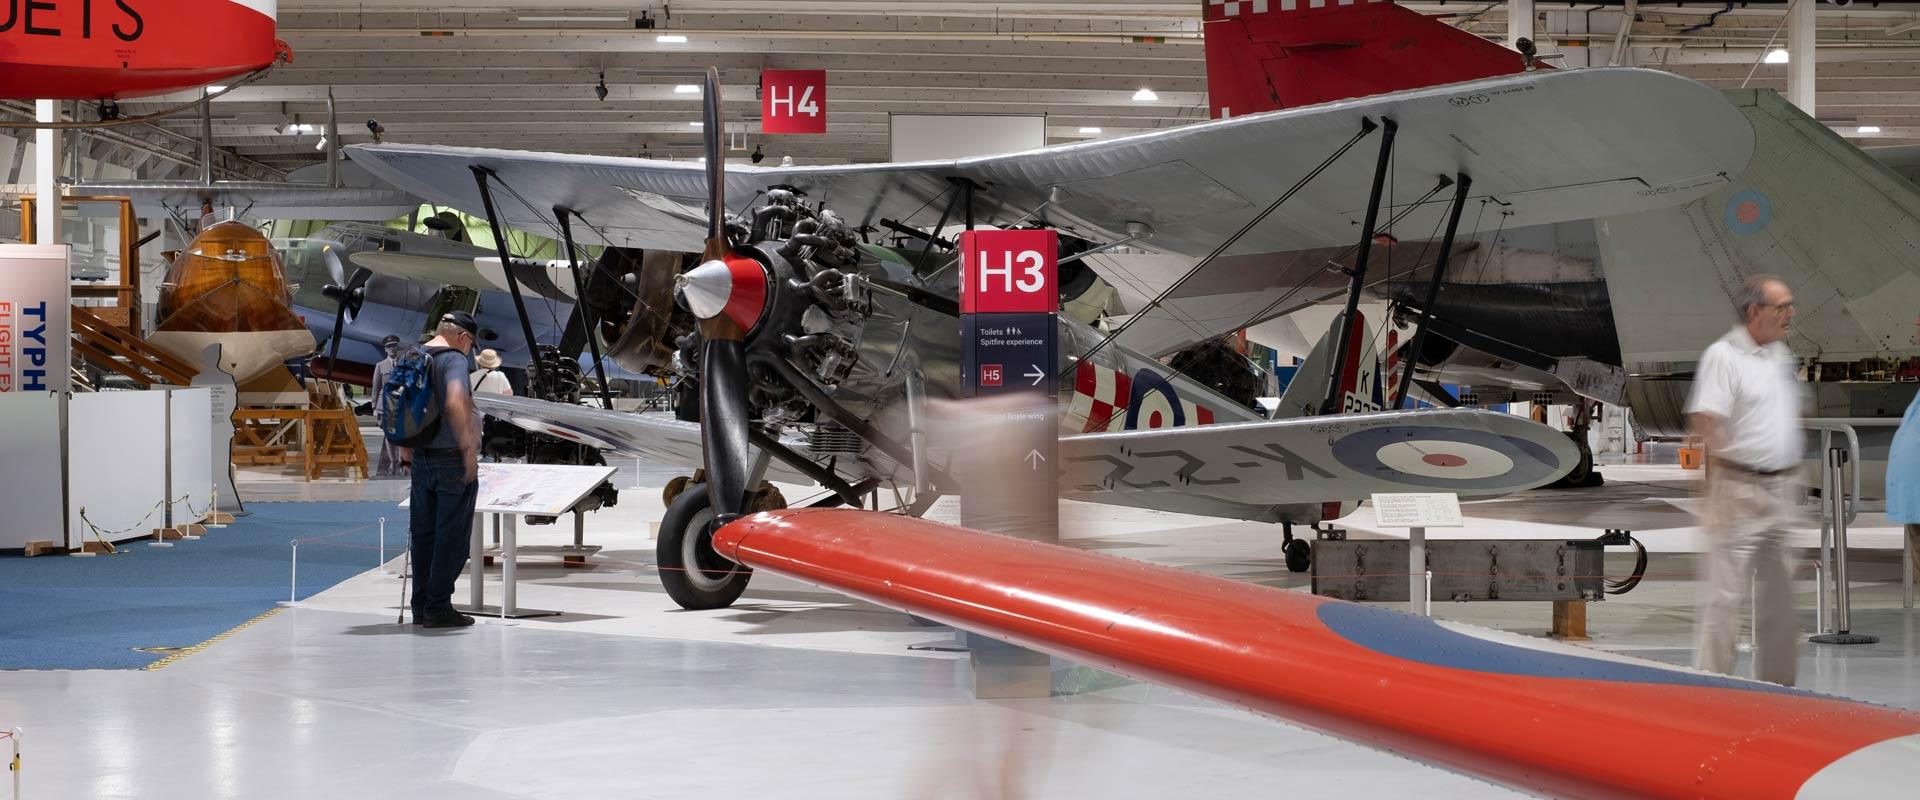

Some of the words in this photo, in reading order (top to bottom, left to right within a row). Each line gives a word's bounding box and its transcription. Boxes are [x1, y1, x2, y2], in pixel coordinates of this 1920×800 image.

[771, 85, 819, 117] H4
[980, 250, 1045, 293] H3
[980, 328, 1004, 336] Toilets
[980, 338, 1005, 347] Spitfire
[1006, 338, 1043, 347] experience
[23, 301, 46, 391] TYPH
[984, 369, 1000, 381] H5
[1360, 370, 1370, 395] K
